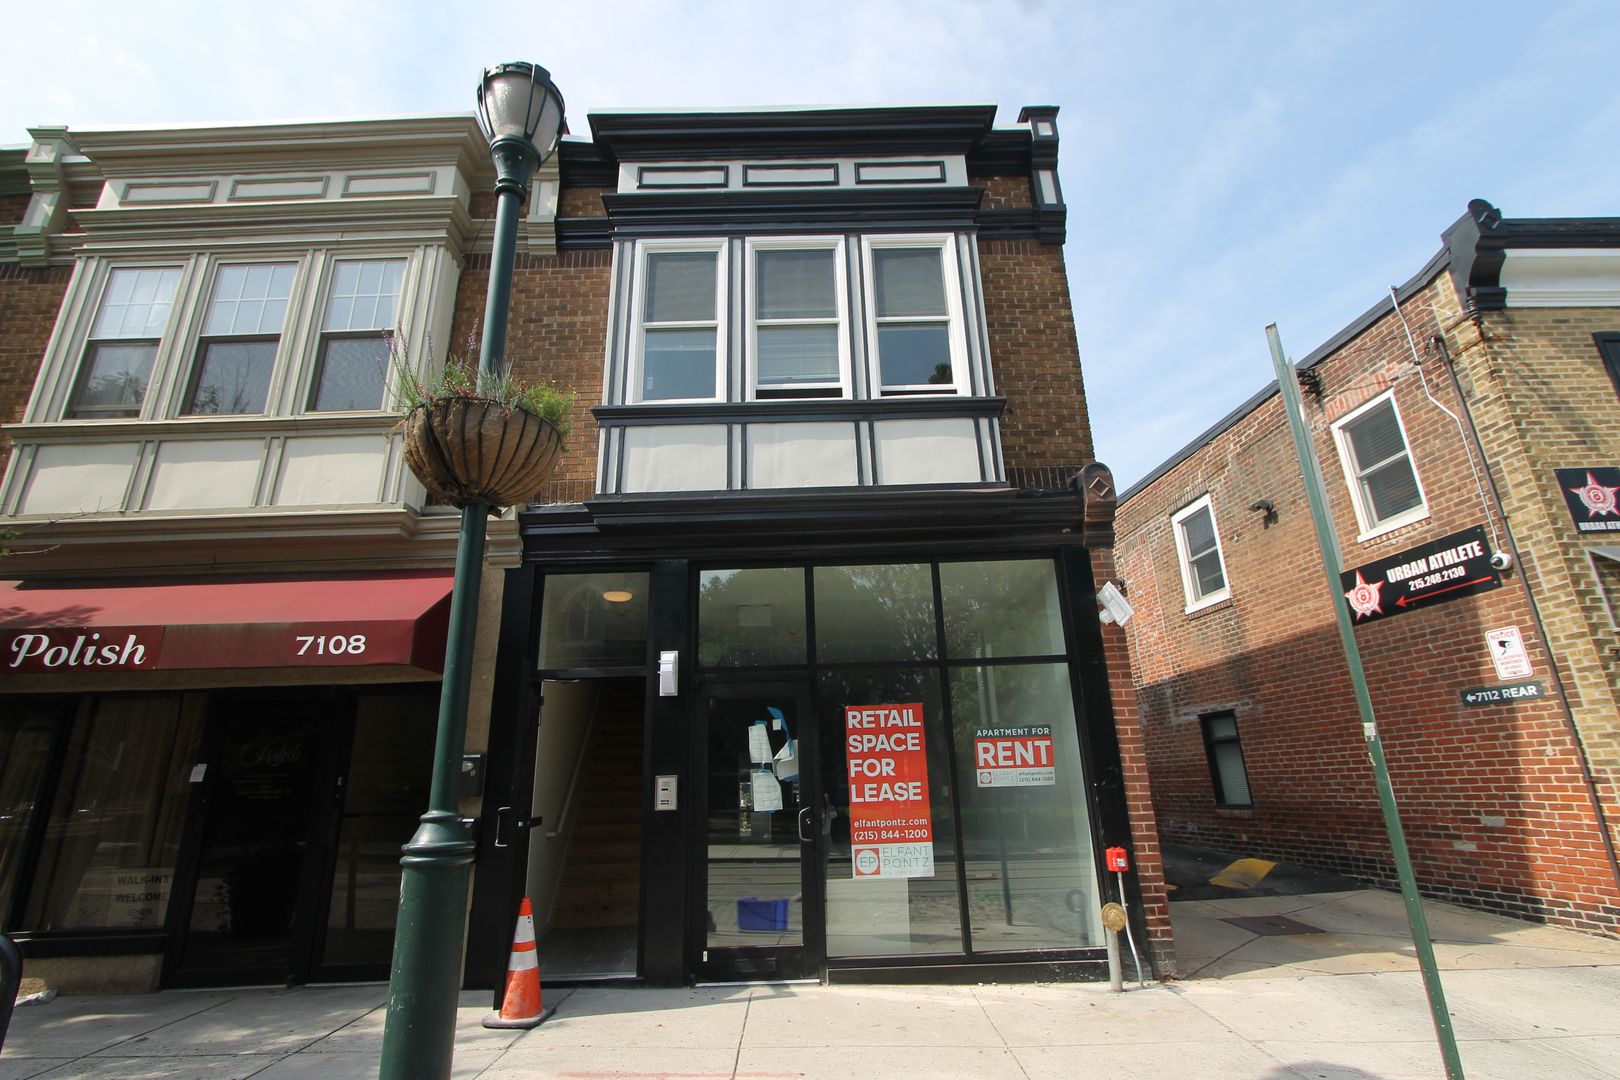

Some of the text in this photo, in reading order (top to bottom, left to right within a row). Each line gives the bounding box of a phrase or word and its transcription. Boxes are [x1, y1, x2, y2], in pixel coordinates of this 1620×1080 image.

[1579, 522, 1606, 531] URBAN
[1386, 540, 1484, 583] URBAN ATHLETE
[1408, 565, 1466, 591] 215.248.2130
[1490, 631, 1516, 640] NOTICE
[9, 633, 146, 668] Polish
[296, 634, 366, 655] 7108
[1475, 685, 1538, 702] 7112 REAR
[847, 708, 922, 729] RETAIL
[976, 727, 1051, 737] APARTMENT FOR
[848, 732, 921, 753] SPACE
[977, 740, 1052, 767] RENT
[849, 758, 897, 777] FOR
[851, 782, 923, 803] LEASE
[854, 818, 928, 829] elfantpontz.com
[854, 829, 928, 841] (215) 844-1200
[882, 845, 929, 858] ELFANT
[860, 856, 877, 868] EP
[883, 857, 929, 869] PONTZ
[118, 874, 169, 885] WALK-INS
[115, 892, 168, 903] WELCOME
